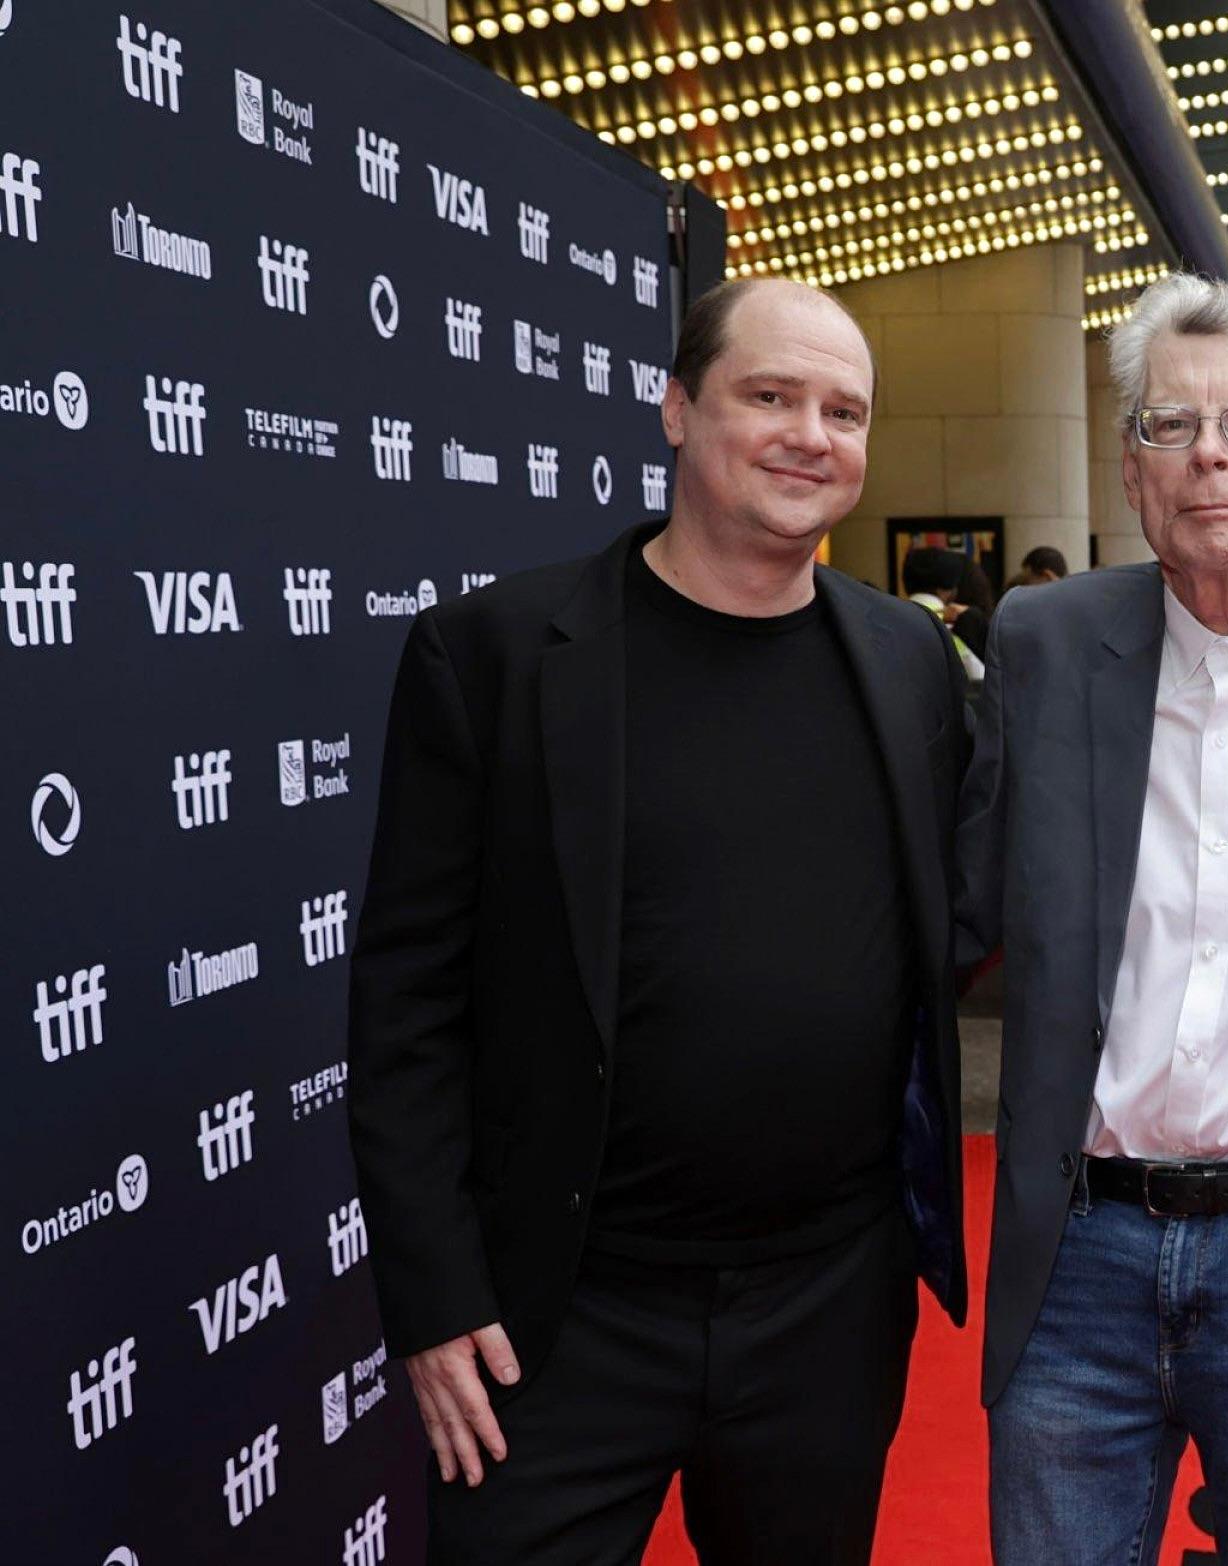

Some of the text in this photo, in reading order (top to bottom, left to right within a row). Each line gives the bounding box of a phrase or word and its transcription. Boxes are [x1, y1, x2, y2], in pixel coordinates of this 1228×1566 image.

[117, 15, 183, 113] tiff
[271, 88, 313, 130] Royal
[273, 126, 313, 165] Bank
[356, 127, 399, 203] tiff
[426, 163, 490, 236] VISA
[138, 214, 211, 280] TORONTO
[518, 202, 549, 264] tiff
[258, 236, 310, 315] tiff
[633, 256, 659, 308] tiff
[445, 298, 482, 362] tiff
[583, 341, 611, 395] tiff
[629, 360, 667, 406] VISA
[144, 375, 206, 456] tiff
[245, 408, 313, 439] TELEFILM
[371, 416, 413, 481] tiff
[528, 444, 558, 498] tiff
[642, 464, 667, 511] tiff
[0, 562, 76, 646] tiff
[134, 571, 240, 634] VISA
[283, 568, 332, 635] tiff
[365, 591, 417, 617] Ontario
[312, 732, 349, 768] Royal
[172, 750, 232, 829] tiff
[313, 768, 349, 799] Bank
[300, 890, 347, 966] tiff
[191, 942, 258, 998] TORONTO
[34, 965, 106, 1062] tiff
[198, 1090, 255, 1181] tiff
[22, 1189, 114, 1254] Ontario
[188, 1254, 287, 1355] VISA
[67, 1337, 136, 1449] tiff
[354, 1375, 387, 1419] Bank
[224, 1425, 279, 1526] tiff
[343, 1496, 387, 1566] tiff
